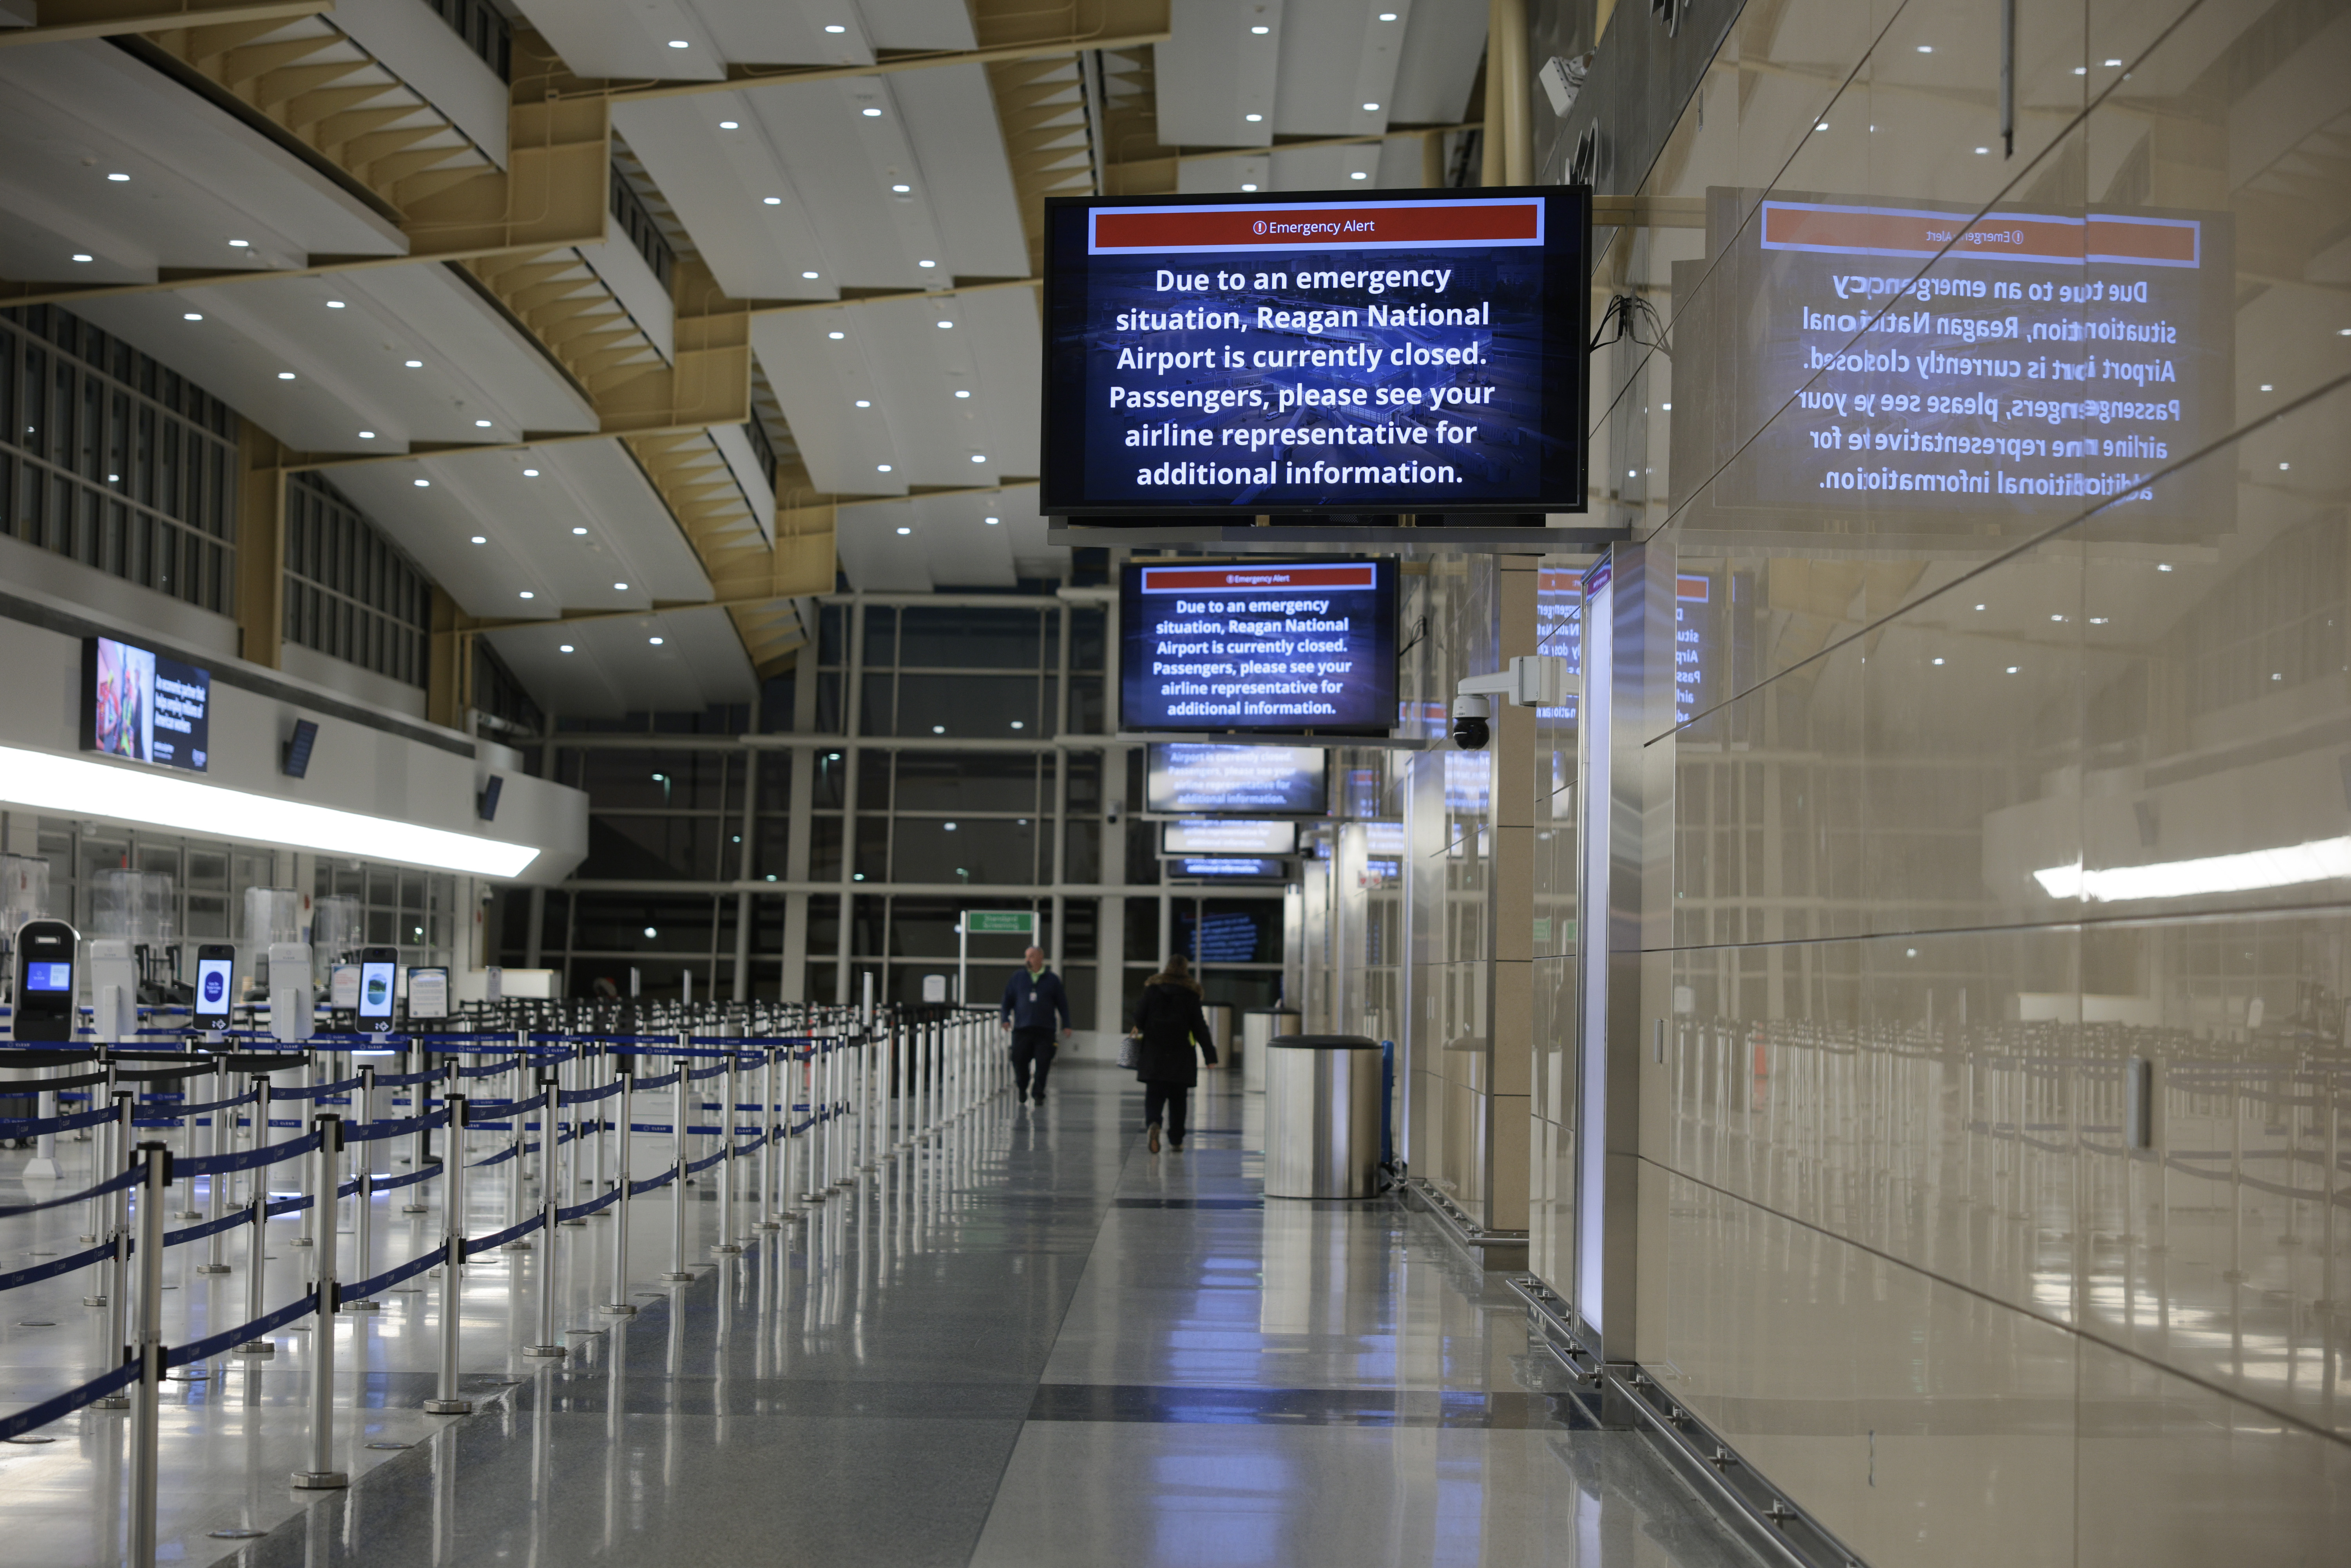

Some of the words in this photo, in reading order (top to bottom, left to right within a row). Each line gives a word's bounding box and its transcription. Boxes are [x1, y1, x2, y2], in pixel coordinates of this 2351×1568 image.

[1270, 222, 1341, 236] Emergency
[1344, 220, 1375, 231] Alert
[1157, 270, 1209, 291] Due
[1217, 271, 1245, 290] to
[1254, 273, 1286, 290] an
[1297, 270, 1451, 294] emergency
[1117, 307, 1247, 332] situation,
[1258, 307, 1357, 334] Reagan
[1369, 302, 1488, 326] National
[1117, 347, 1215, 375] Airport
[1225, 346, 1244, 368] is
[1253, 343, 1383, 372] currently
[1391, 341, 1486, 365] closed.
[1111, 387, 1269, 413] Passengers,
[1279, 383, 1367, 413] please
[1376, 388, 1422, 405] see
[1430, 387, 1495, 411] your
[1125, 424, 1213, 446] airline
[1223, 421, 1427, 452] representative
[1436, 420, 1477, 443] for
[1137, 461, 1276, 485] additional
[1287, 460, 1462, 483] information.
[1235, 575, 1272, 584] Emergency
[1177, 601, 1205, 613] Due
[1209, 601, 1223, 612] to
[1227, 602, 1245, 612] an
[1249, 601, 1328, 614] emergency
[1157, 621, 1224, 634] situation,
[1229, 621, 1281, 636] Reagan
[1286, 618, 1348, 632] National
[1157, 641, 1208, 657] Airport
[1212, 641, 1223, 653] is
[1227, 639, 1294, 655] currently
[1298, 639, 1347, 652] closed.
[1154, 663, 1236, 677] Passengers,
[1241, 661, 1286, 677] please
[1290, 663, 1314, 672] see
[1318, 663, 1351, 675] your
[1162, 682, 1208, 694] airline
[1212, 681, 1317, 697] representative
[1321, 680, 1342, 693] for
[1168, 701, 1240, 715] additional
[1245, 701, 1335, 714] information.
